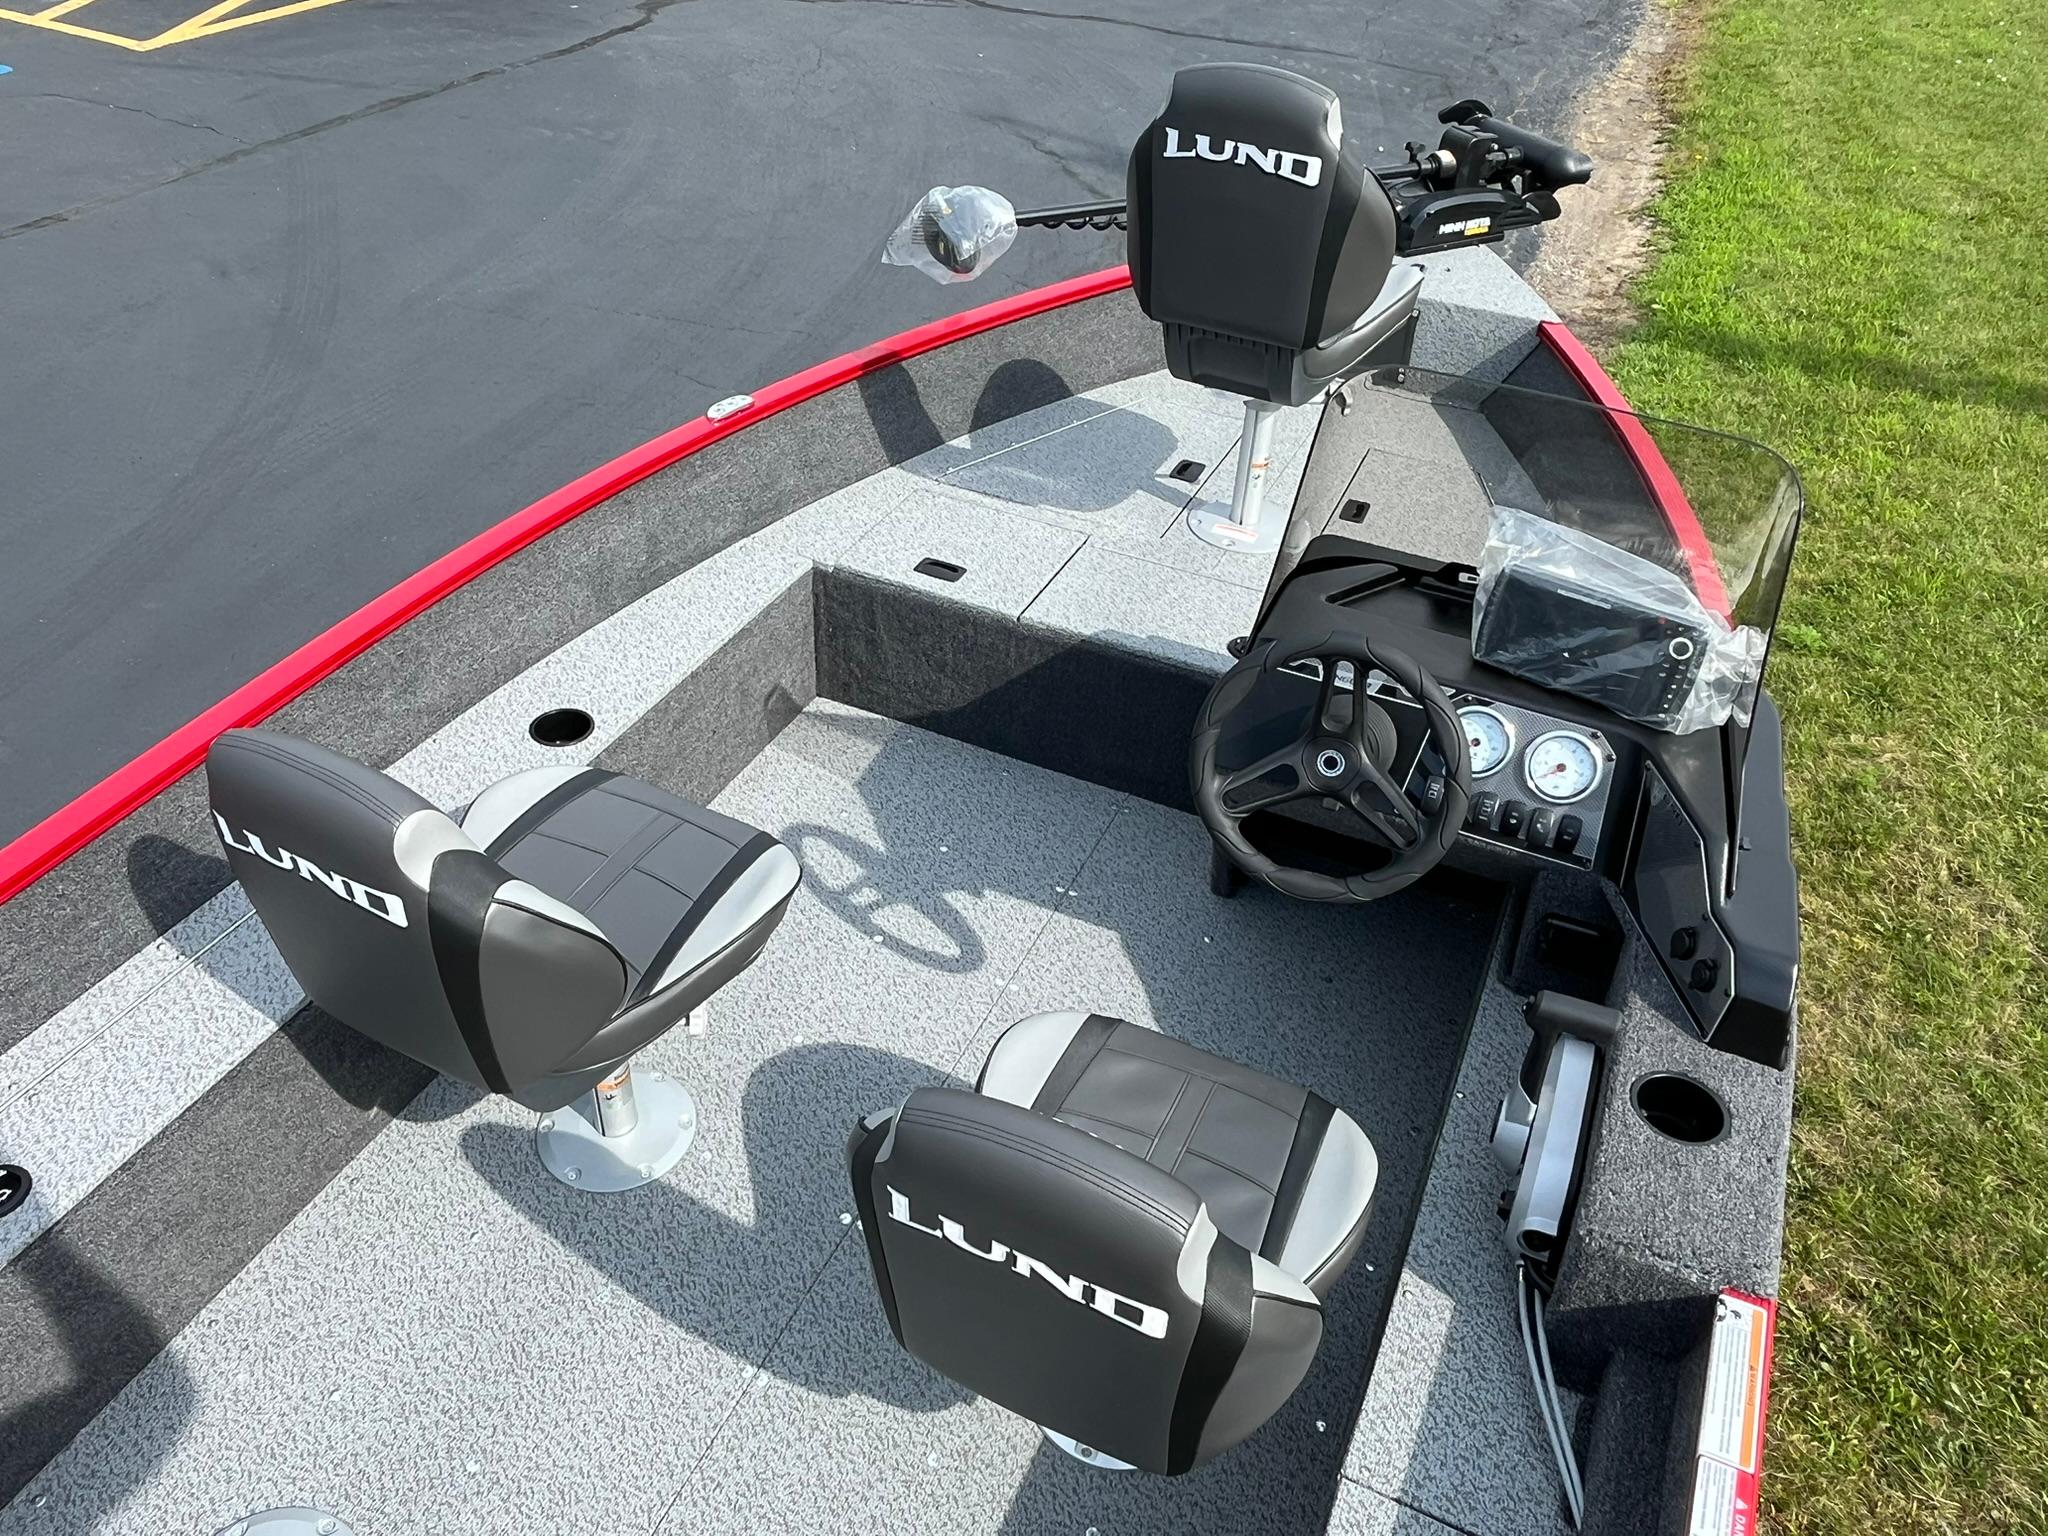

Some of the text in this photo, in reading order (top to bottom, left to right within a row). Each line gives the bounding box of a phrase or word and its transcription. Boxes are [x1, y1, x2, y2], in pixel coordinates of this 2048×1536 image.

[1163, 127, 1323, 188] LUND
[212, 809, 409, 929] LUND
[886, 1184, 1169, 1339] LUND
